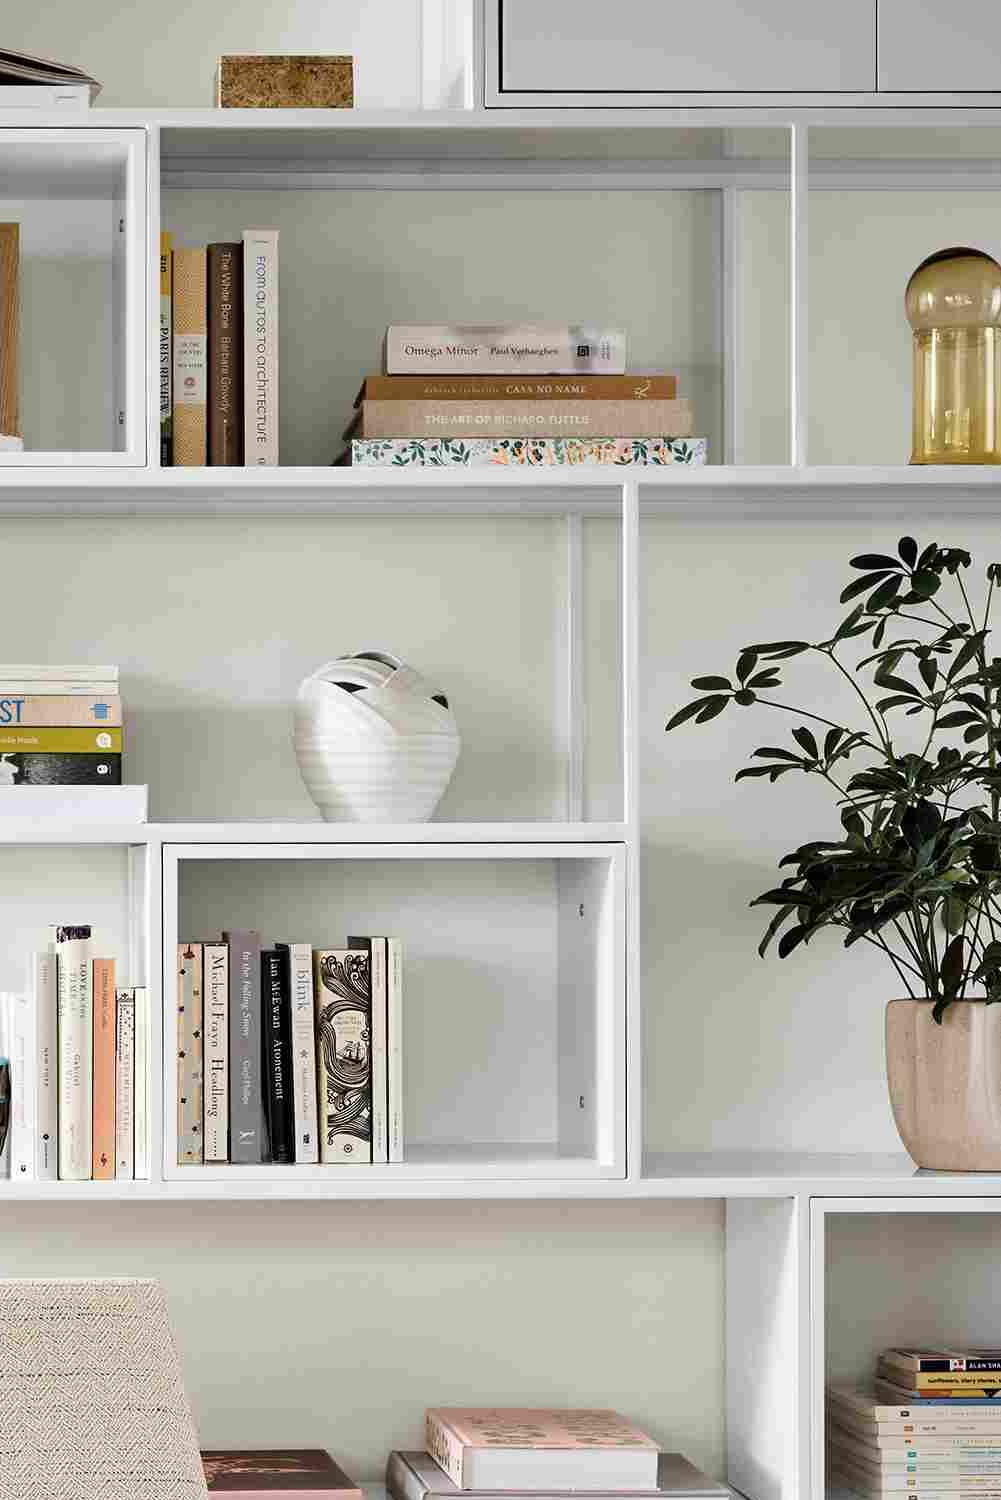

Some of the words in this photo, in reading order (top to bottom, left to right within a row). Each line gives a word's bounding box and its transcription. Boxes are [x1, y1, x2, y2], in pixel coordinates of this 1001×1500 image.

[222, 252, 232, 270] The
[221, 272, 231, 301] White
[221, 303, 231, 328] Bone
[160, 327, 169, 364] PARIS
[404, 345, 442, 357] Omega
[446, 345, 479, 355] Minor
[160, 366, 169, 416] REVIEW
[219, 376, 231, 413] Gowdy
[536, 384, 551, 393] NO
[555, 384, 586, 393] NAME
[424, 415, 448, 424] THE
[450, 415, 472, 424] ART
[474, 415, 490, 424] OF
[494, 415, 545, 424] RICHARD
[211, 954, 225, 1005] Michael
[270, 957, 281, 977] Ian
[271, 980, 282, 1029] McEwan
[296, 969, 312, 1010] blink
[207, 1013, 225, 1048] Frayn
[273, 1039, 284, 1099] Atonement
[207, 1059, 225, 1117] Headlong
